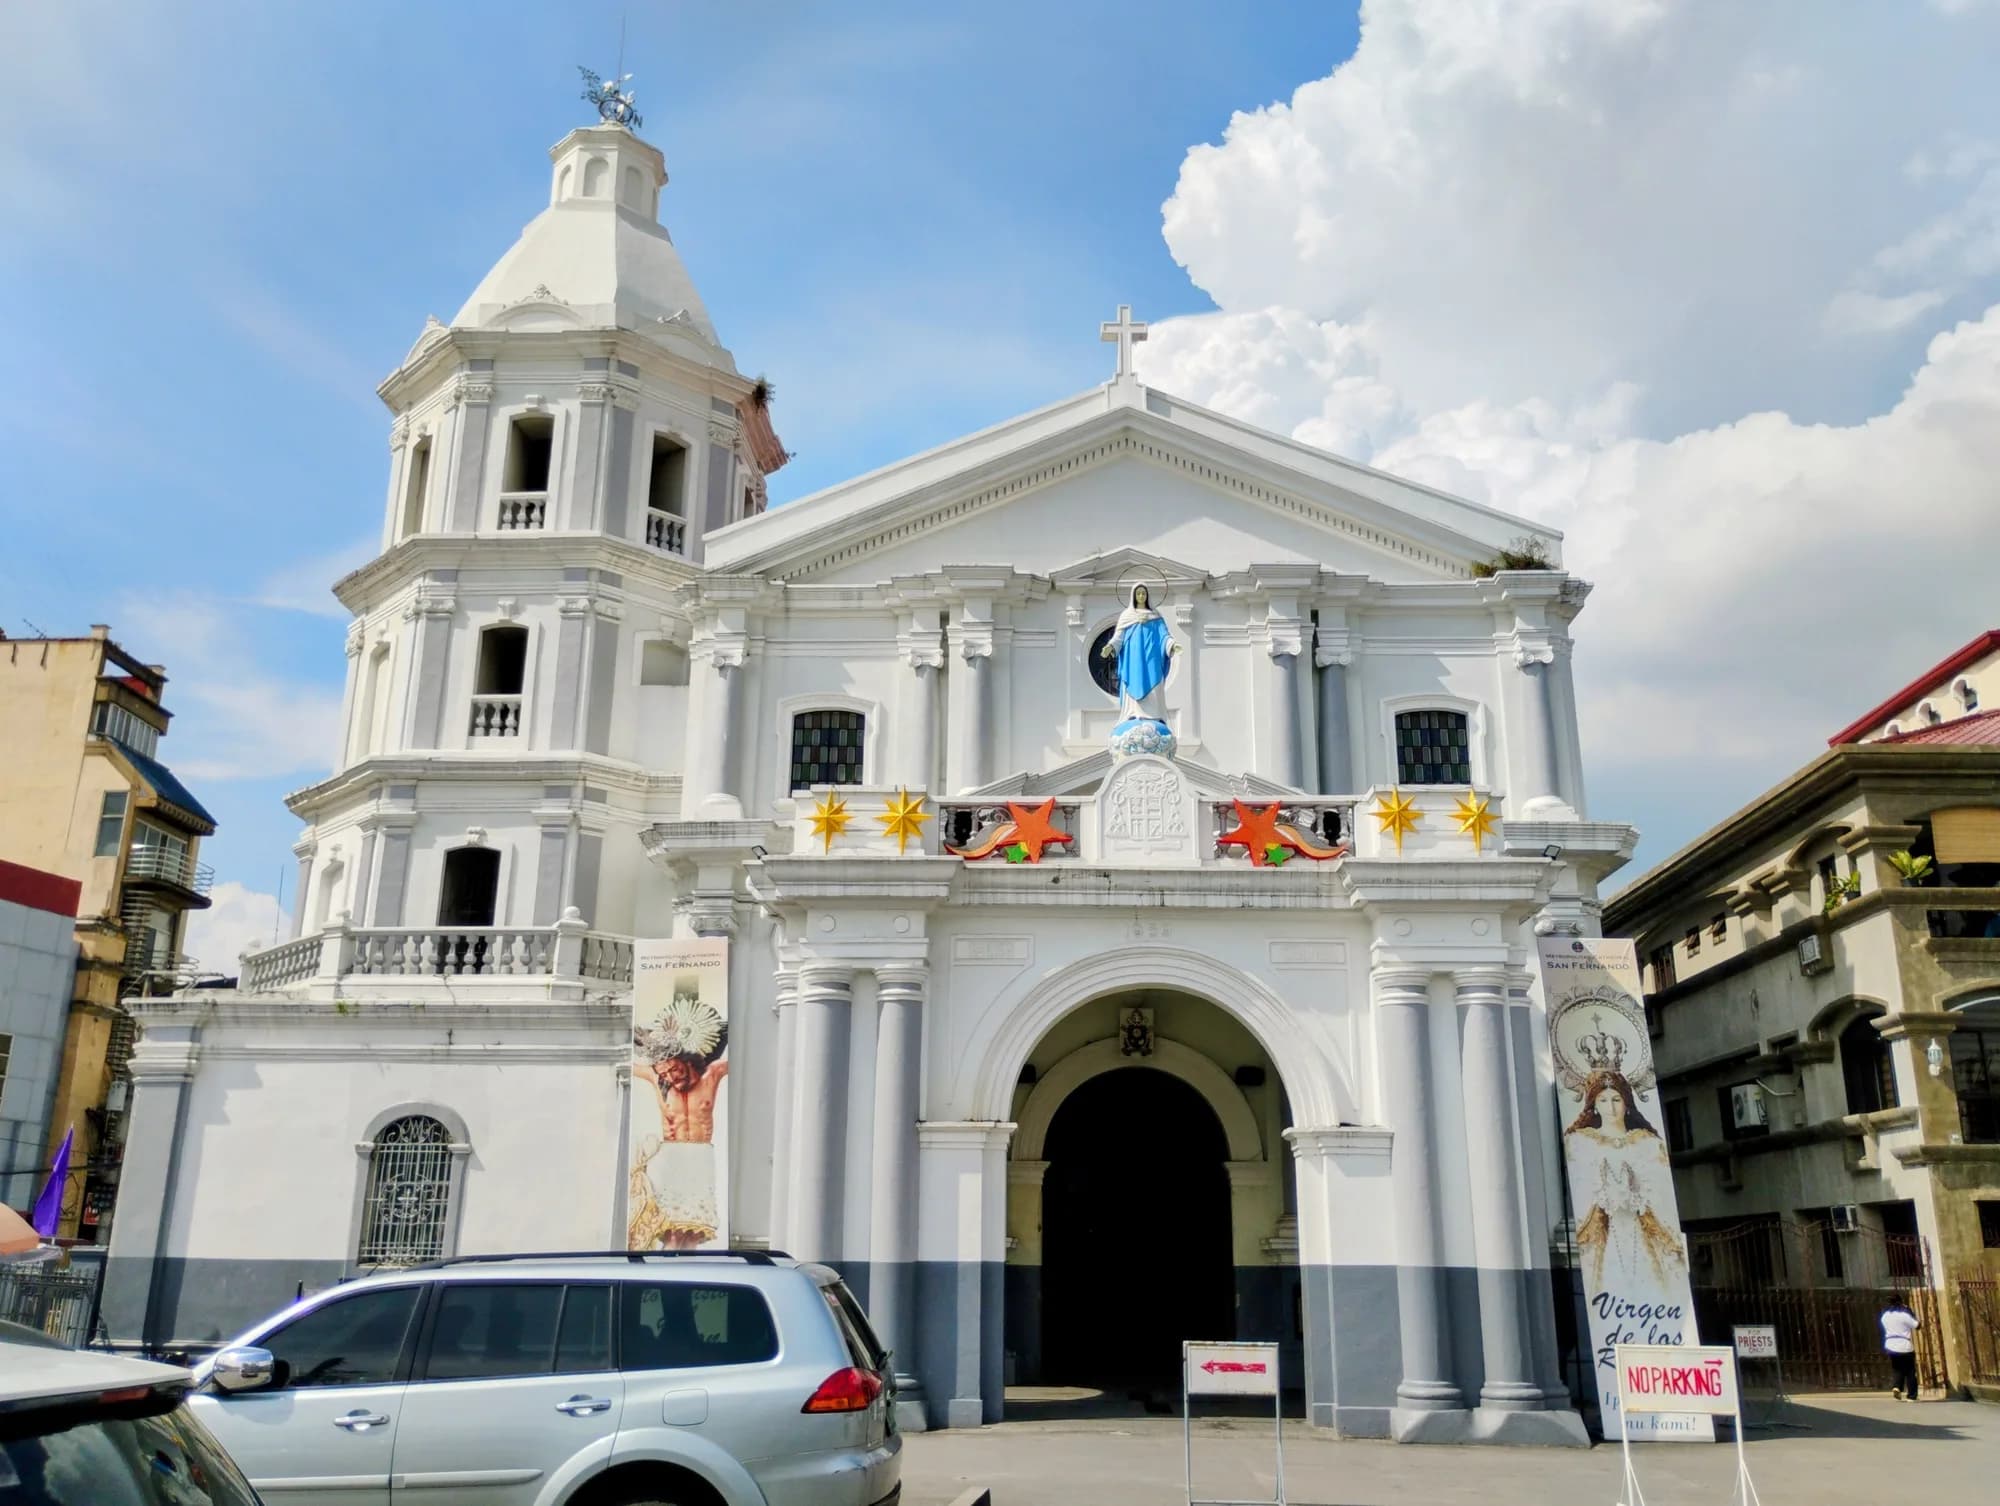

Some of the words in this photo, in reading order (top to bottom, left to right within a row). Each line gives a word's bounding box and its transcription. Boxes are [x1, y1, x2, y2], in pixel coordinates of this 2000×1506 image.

[640, 962, 662, 970] SAN
[665, 960, 721, 969] FERNANDO
[1547, 961, 1569, 969] SAN
[1572, 962, 1630, 970] FERNANDO
[1592, 1291, 1682, 1328] Virgen
[1605, 1323, 1635, 1346] de
[1648, 1323, 1685, 1345] los
[1737, 1335, 1774, 1348] PRIESTS
[1651, 1415, 1696, 1431] kami!
